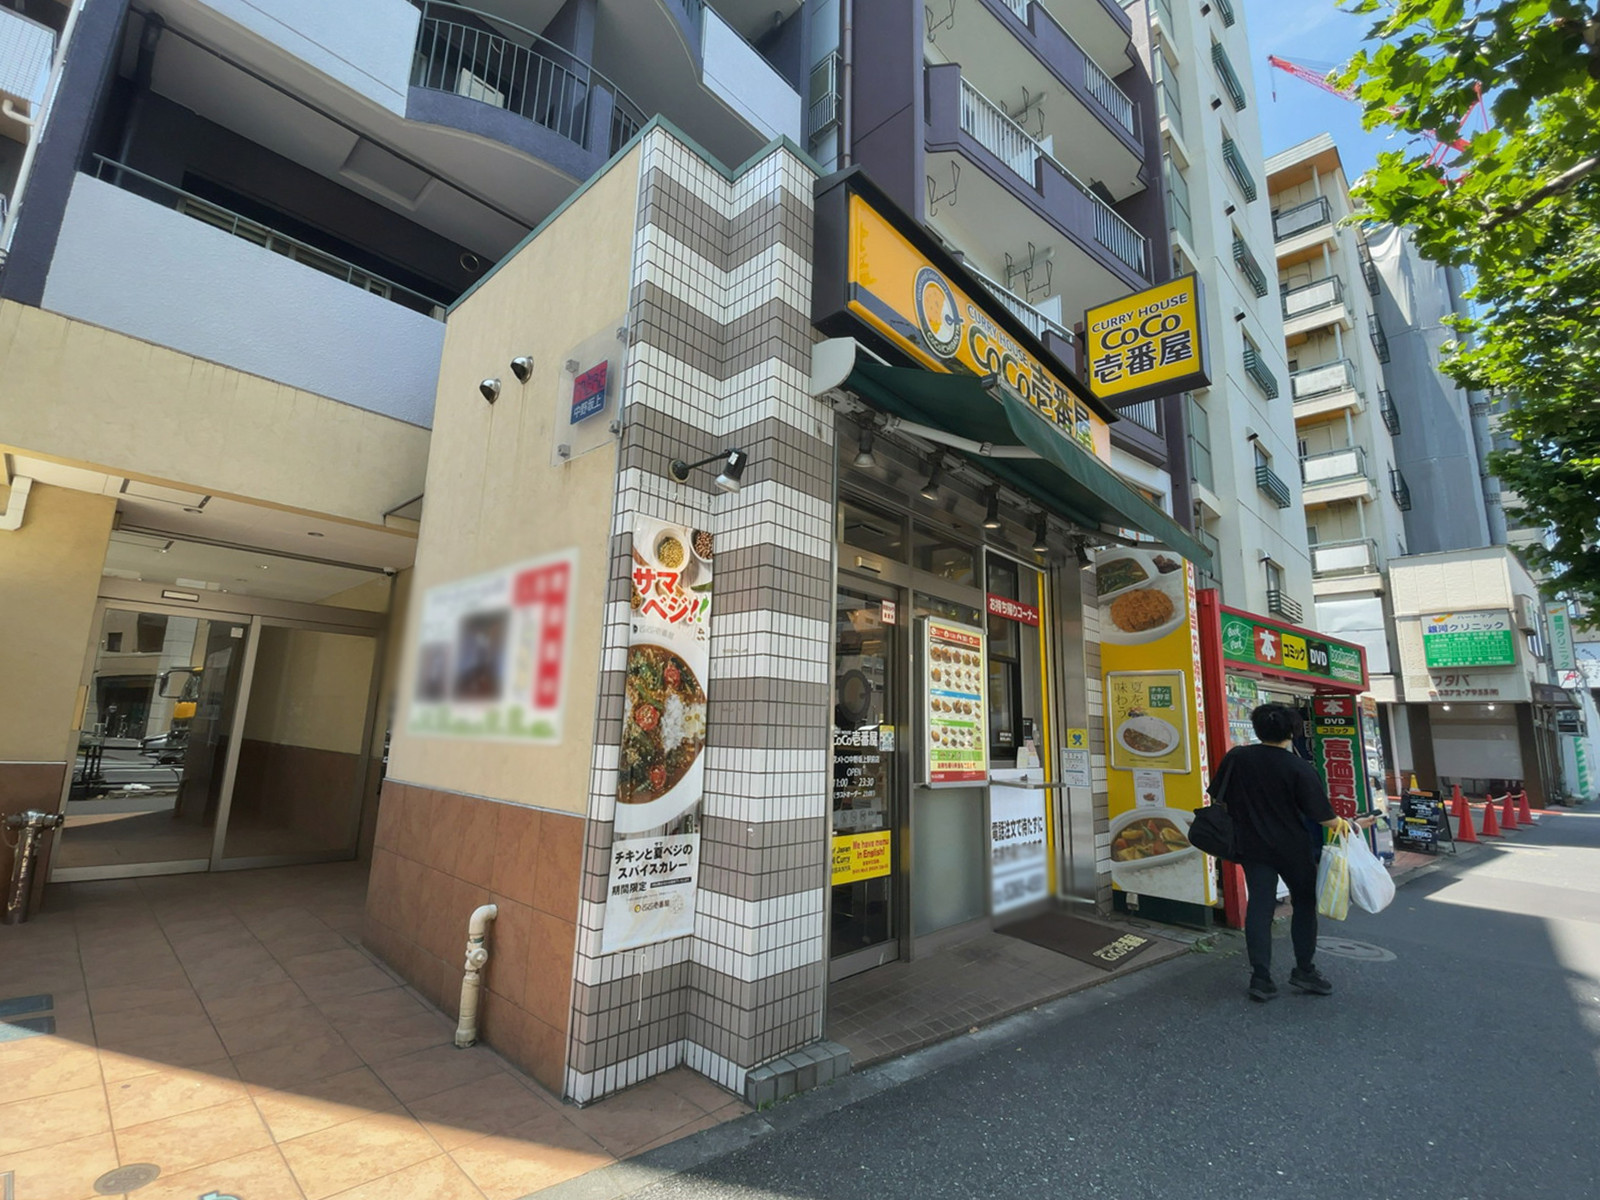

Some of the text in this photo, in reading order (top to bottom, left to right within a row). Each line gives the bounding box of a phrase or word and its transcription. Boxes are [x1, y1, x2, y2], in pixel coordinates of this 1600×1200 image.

[1092, 292, 1188, 333] CURRY HOUSE
[967, 303, 1030, 367] CURRY HOUSE
[1100, 312, 1182, 351] CoCo
[1093, 329, 1193, 384] 壱番屋
[573, 394, 602, 418] 中野坂上
[633, 568, 679, 595] サマ
[990, 598, 1038, 621] お持ち帰りコーナー
[1428, 621, 1504, 633] 銀河クリニック
[1259, 629, 1277, 661] 本
[1283, 643, 1305, 662] コミック
[1310, 648, 1327, 667] DVD
[1432, 674, 1470, 687] フタバ
[1322, 700, 1344, 715] 本
[846, 767, 861, 777] OPEN
[992, 816, 1043, 842] 電話注文で待たずに
[615, 844, 693, 864] チキンと夏ベジの
[618, 861, 688, 879] スパイスカレー
[612, 881, 647, 896] 期間限定
